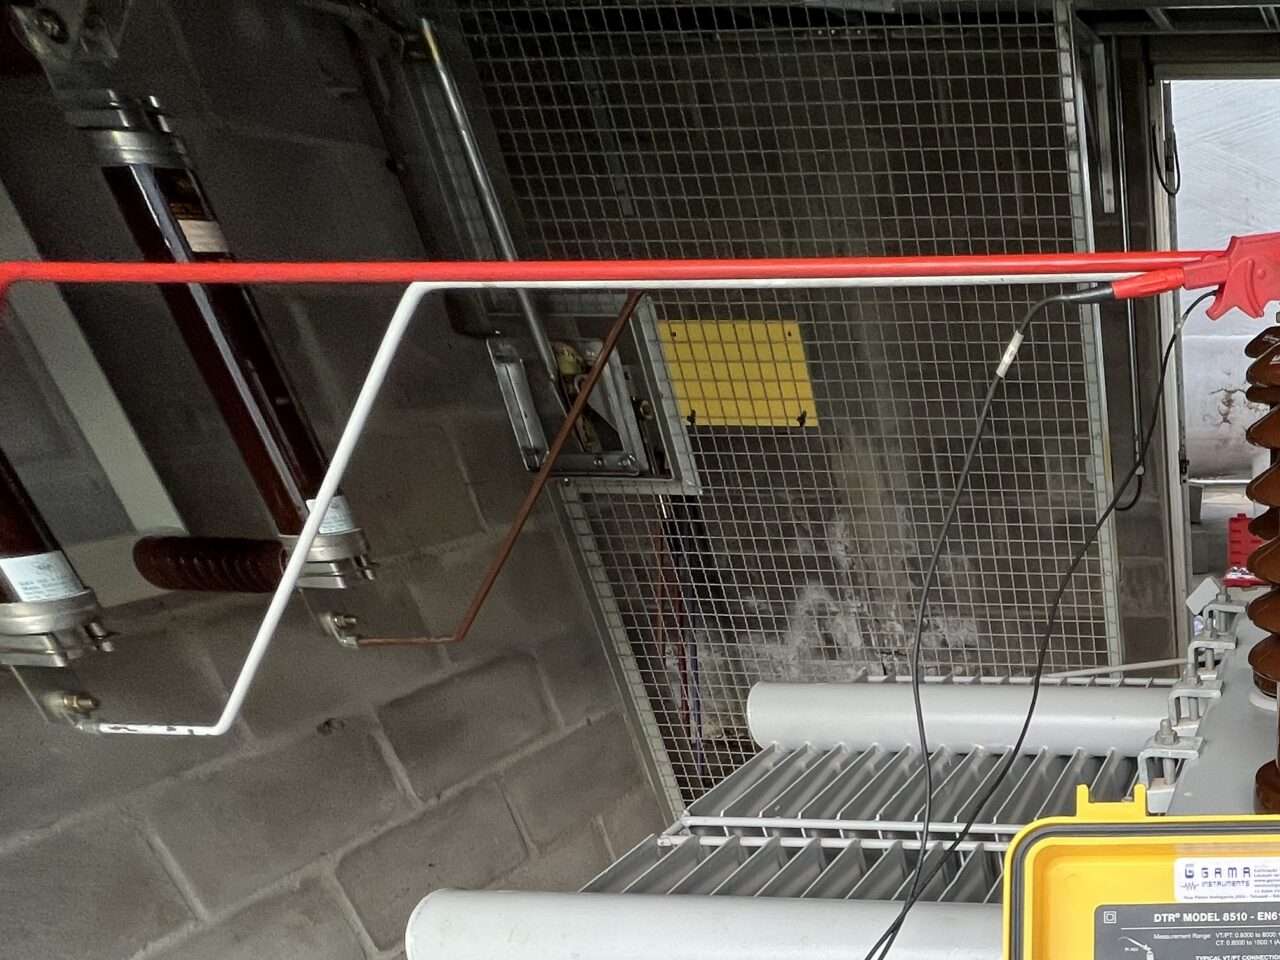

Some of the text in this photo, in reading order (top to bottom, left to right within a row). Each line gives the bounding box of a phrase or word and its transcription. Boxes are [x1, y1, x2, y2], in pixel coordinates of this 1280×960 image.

[1201, 866, 1251, 879] GAMA
[1153, 912, 1181, 923] DTR®
[1183, 912, 1220, 922] MODEL
[1222, 911, 1248, 921] 8510
